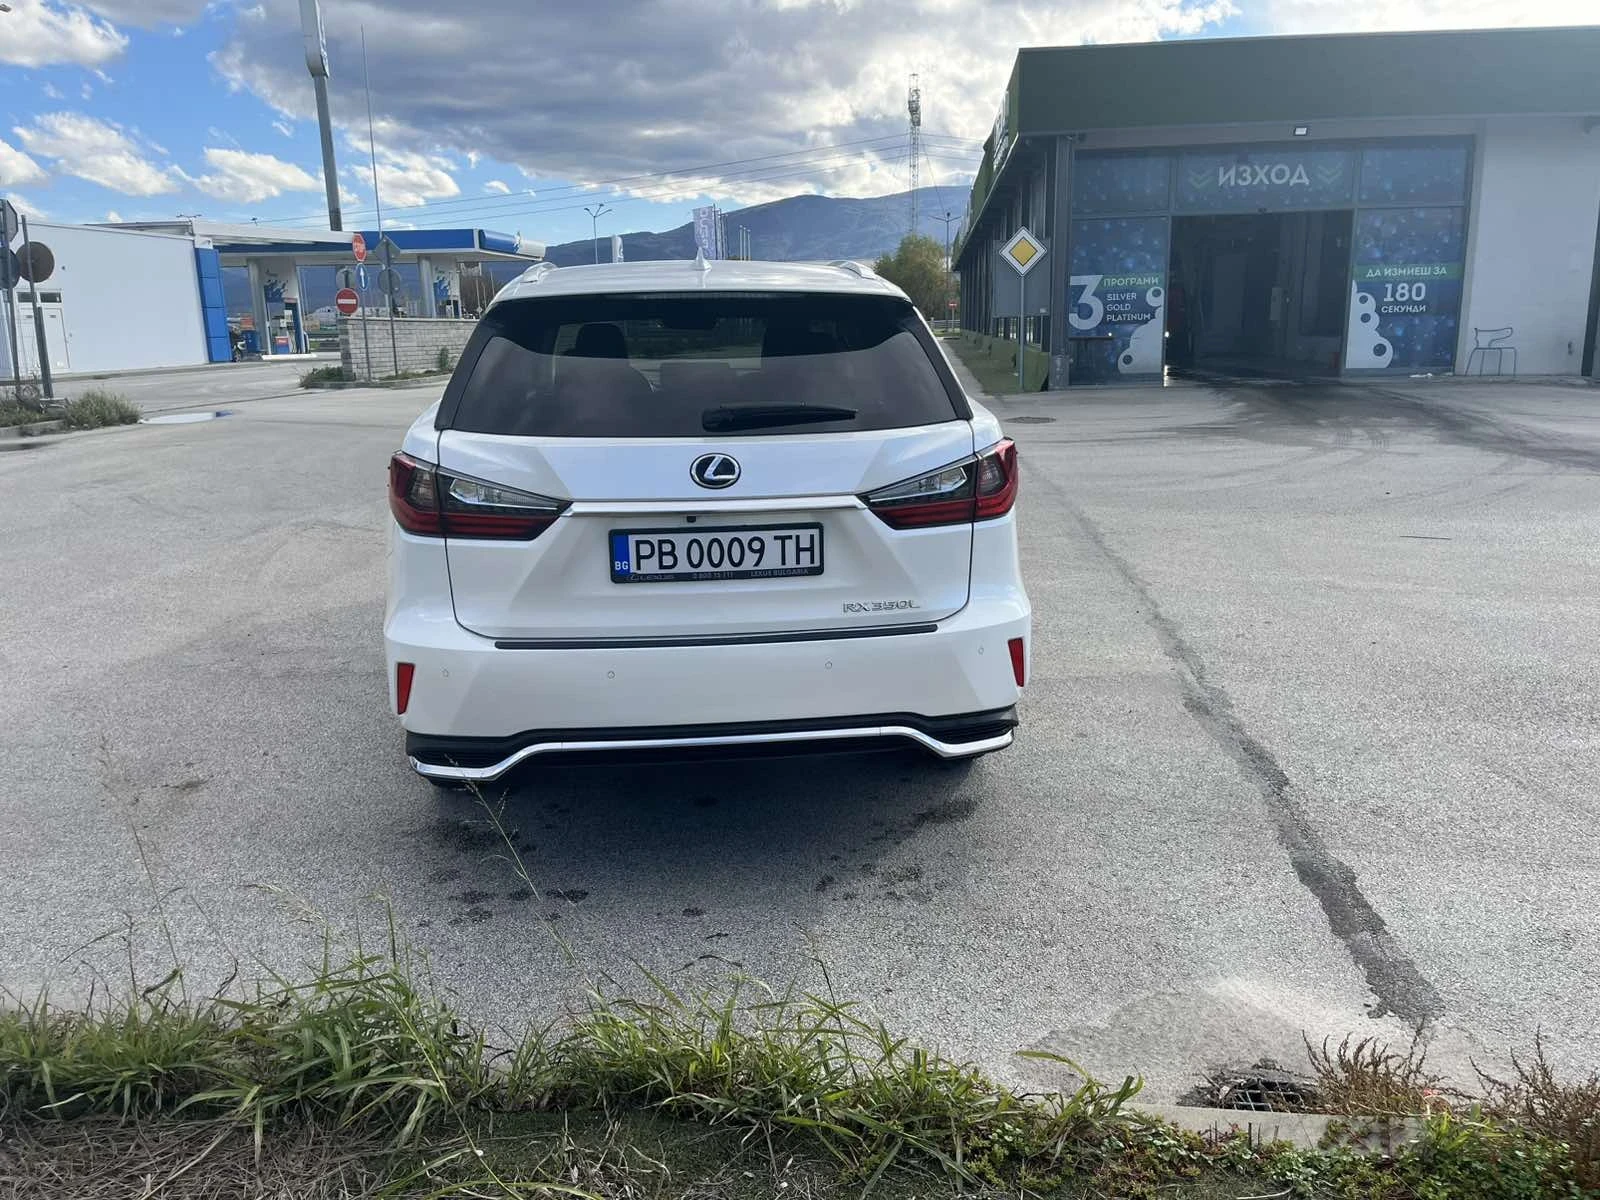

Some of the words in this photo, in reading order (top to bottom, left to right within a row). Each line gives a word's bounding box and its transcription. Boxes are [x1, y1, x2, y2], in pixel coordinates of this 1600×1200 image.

[1218, 164, 1310, 186] ИЗХОД
[1366, 268, 1382, 278] ДА
[1384, 266, 1431, 277] ИЗМИЕШ
[1432, 266, 1447, 276] ЗА
[1103, 276, 1160, 287] ПРОГРАМИ
[1106, 292, 1137, 301] SILVER
[1383, 282, 1427, 302] 180
[1068, 274, 1104, 331] 3
[1106, 303, 1131, 311] GOLD
[1381, 304, 1426, 313] СЕКУНДИ
[1106, 313, 1151, 322] PLATINUM
[635, 538, 678, 571] PB
[686, 536, 765, 569] 0009
[774, 534, 815, 566] TH
[614, 561, 629, 571] BG
